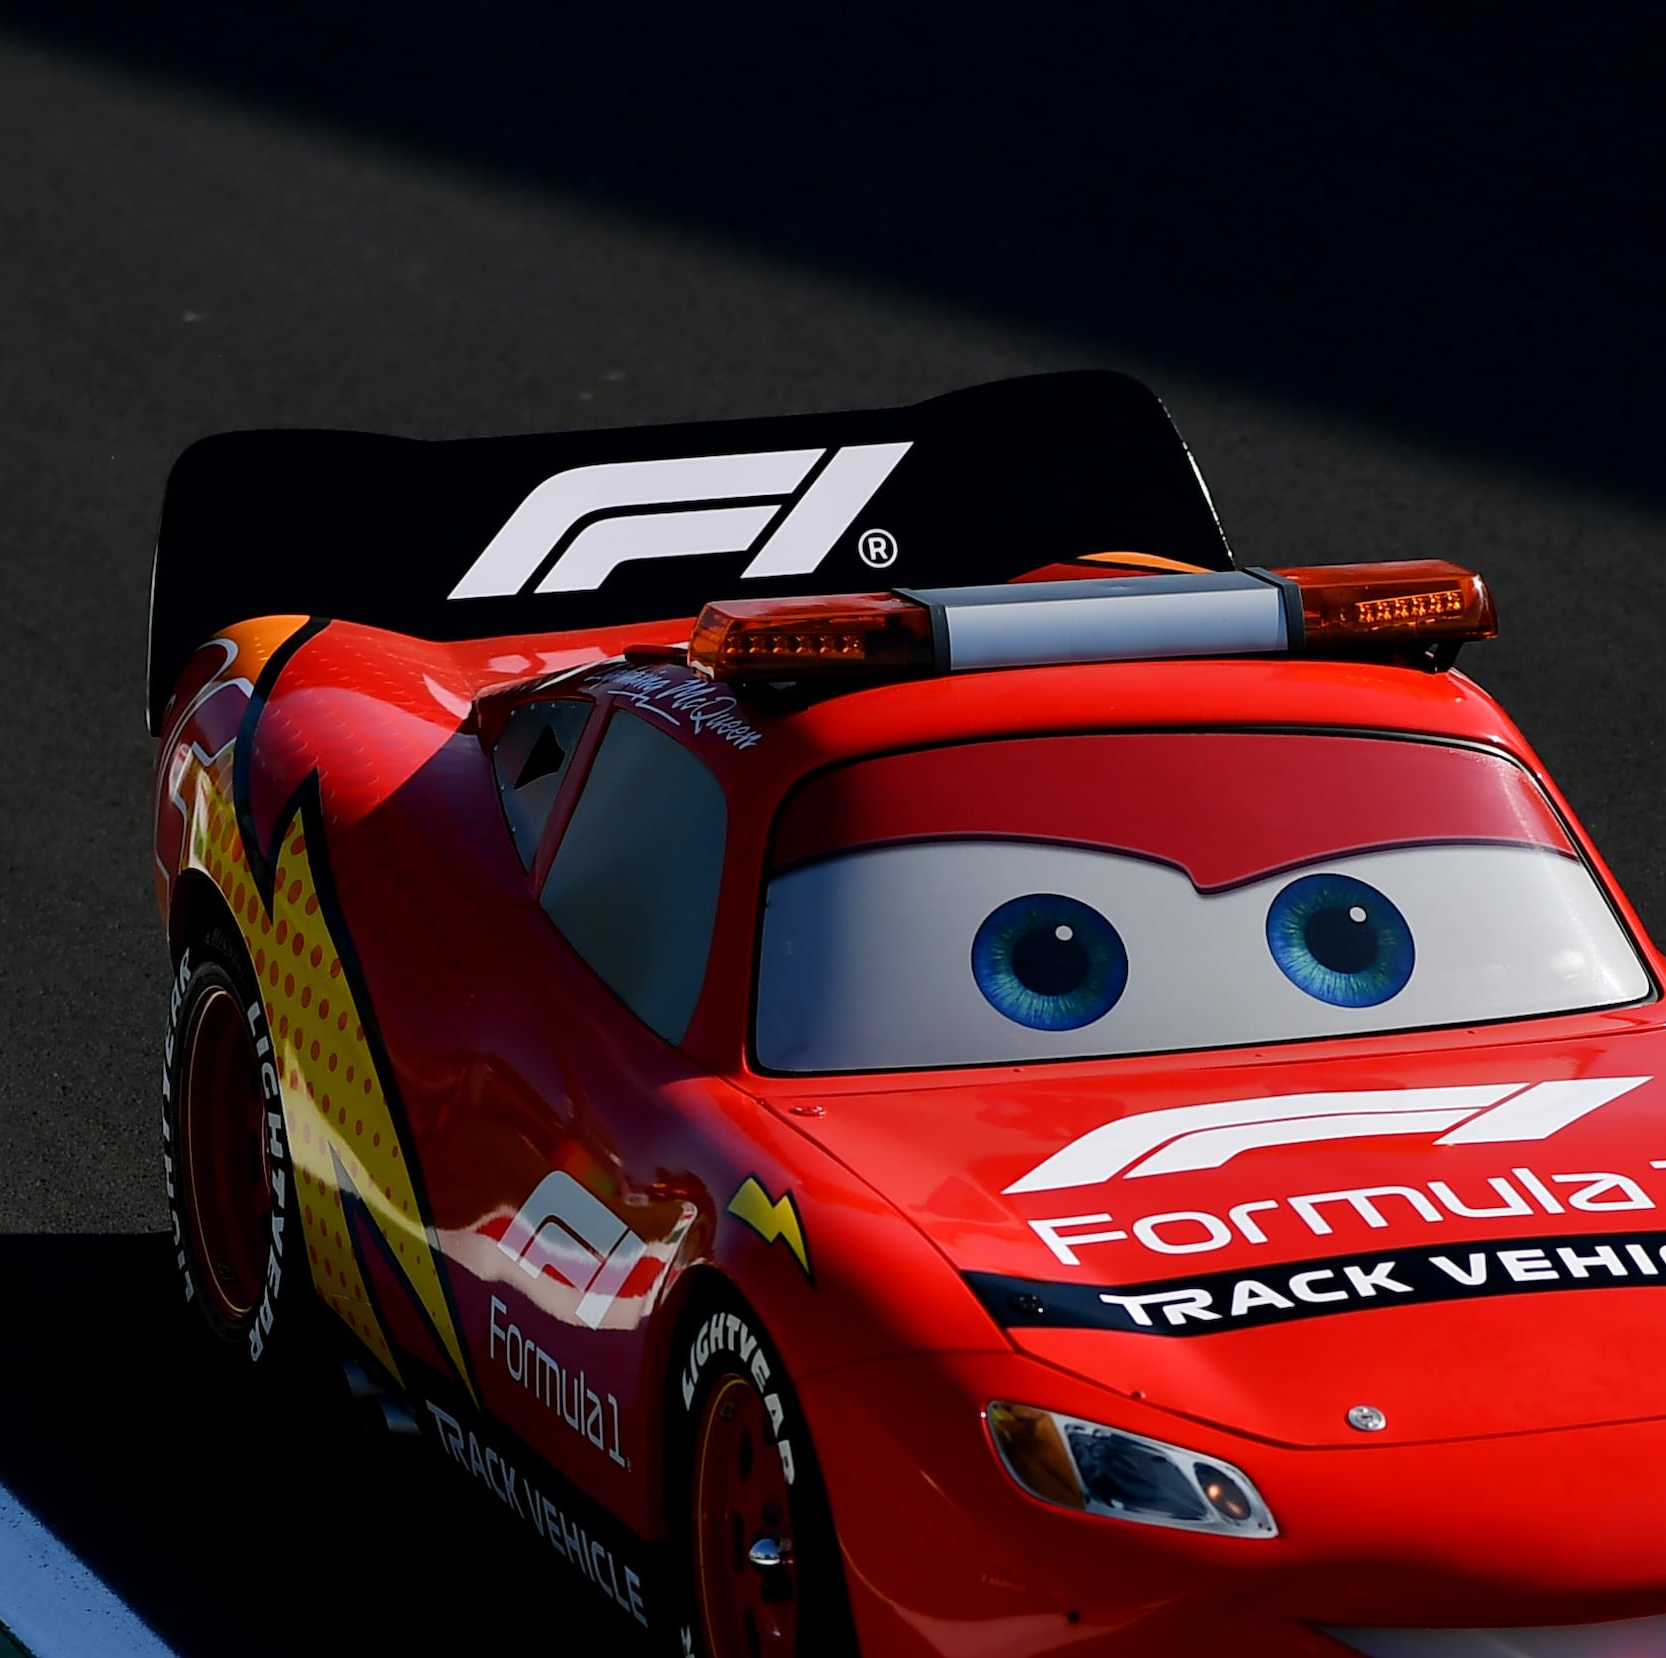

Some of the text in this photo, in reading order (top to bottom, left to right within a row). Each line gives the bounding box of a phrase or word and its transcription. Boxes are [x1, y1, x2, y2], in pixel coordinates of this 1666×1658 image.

[654, 677, 763, 750] McQueen
[1099, 1261, 1415, 1326] TRACK
[425, 1399, 649, 1628] TRACK VEHICLE
